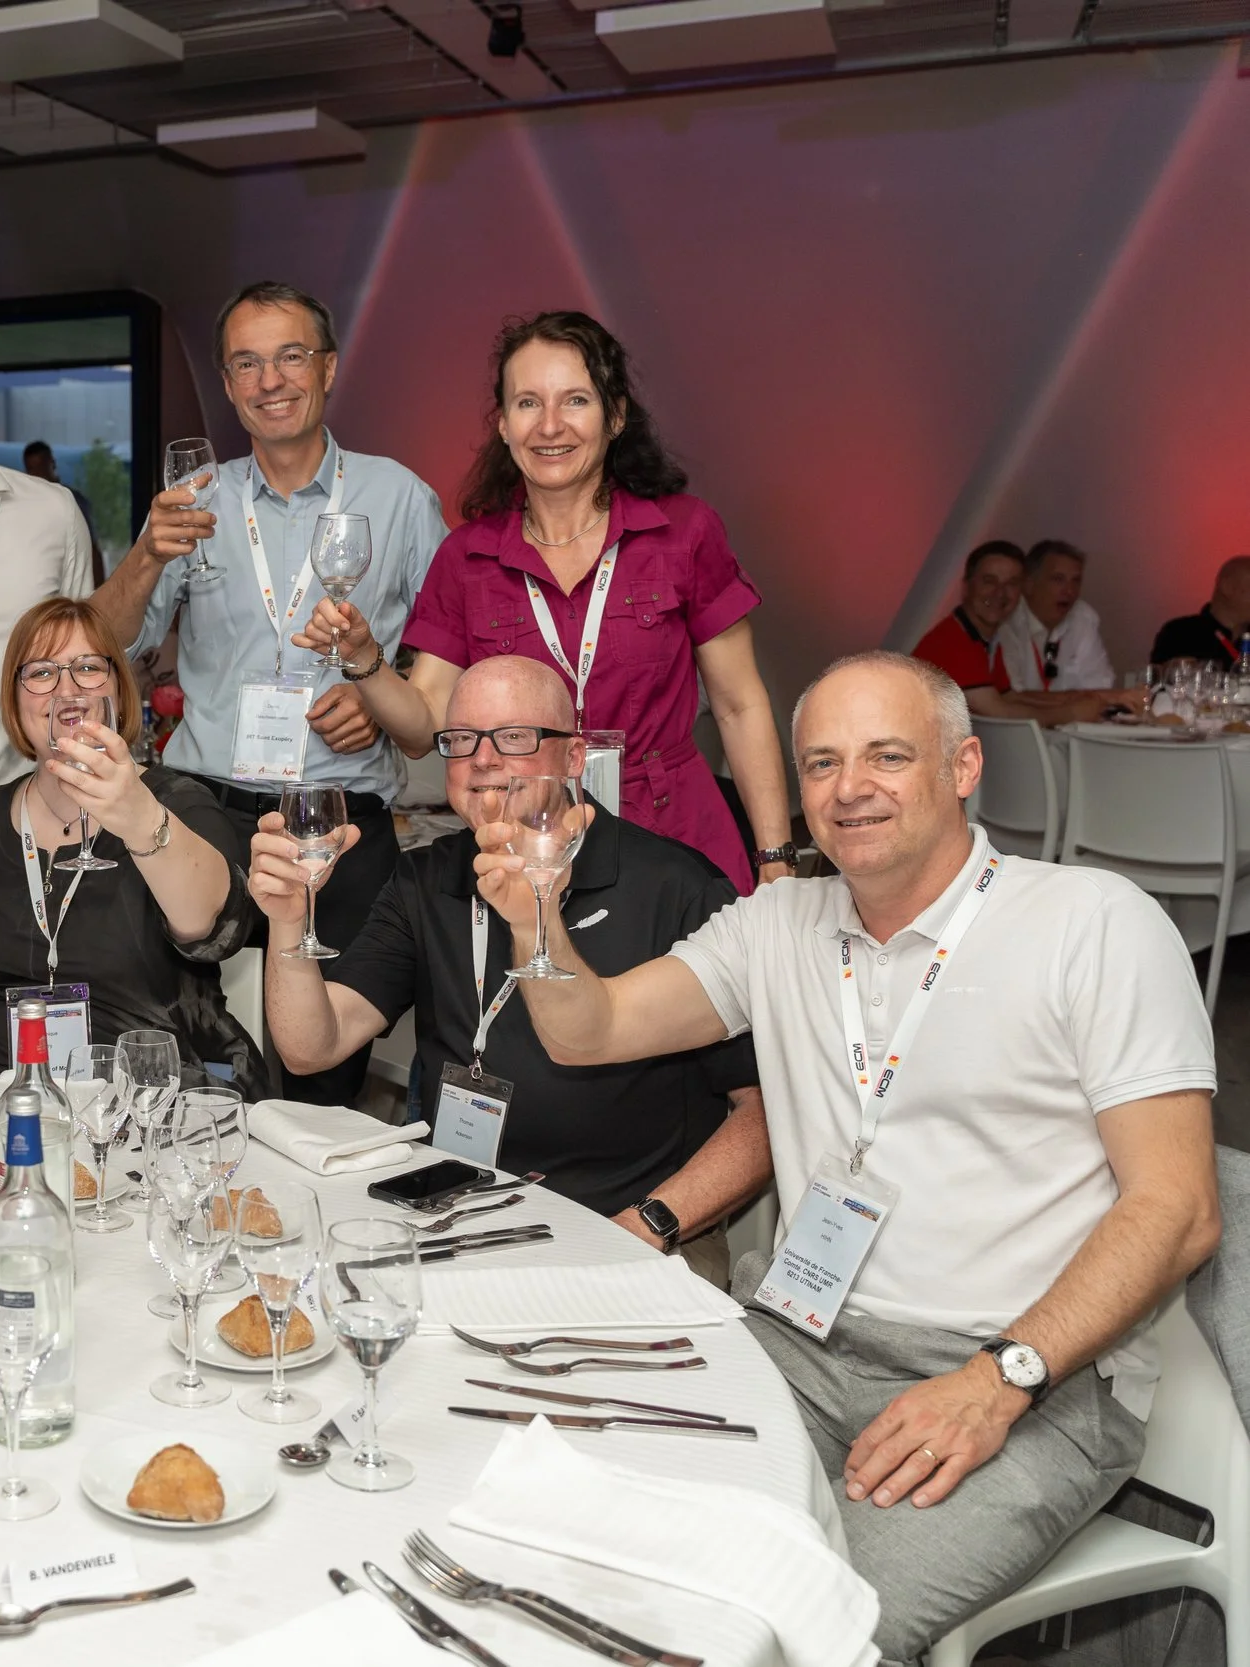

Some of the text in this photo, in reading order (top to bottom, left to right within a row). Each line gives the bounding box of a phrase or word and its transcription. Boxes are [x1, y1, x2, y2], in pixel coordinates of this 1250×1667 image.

[250, 526, 259, 545] ECM
[598, 570, 609, 591] ECM
[267, 598, 277, 618] ECM
[291, 588, 303, 608] ECM
[551, 642, 564, 664] ECM
[581, 653, 591, 676] ECM
[976, 868, 994, 893] ECM
[35, 900, 44, 921] ECM
[476, 902, 484, 926] ECM
[842, 938, 850, 966] ECM
[922, 962, 941, 992] ECM
[499, 979, 516, 1001] ECM
[852, 1043, 864, 1072] ECM
[875, 1069, 894, 1098] ECM
[783, 1258, 833, 1289] Comté, CNRS UMR
[784, 1248, 842, 1283] Université de Franche-
[787, 1270, 822, 1293] 6213 UTINAM
[29, 1553, 116, 1581] B. VANDEWIELE
